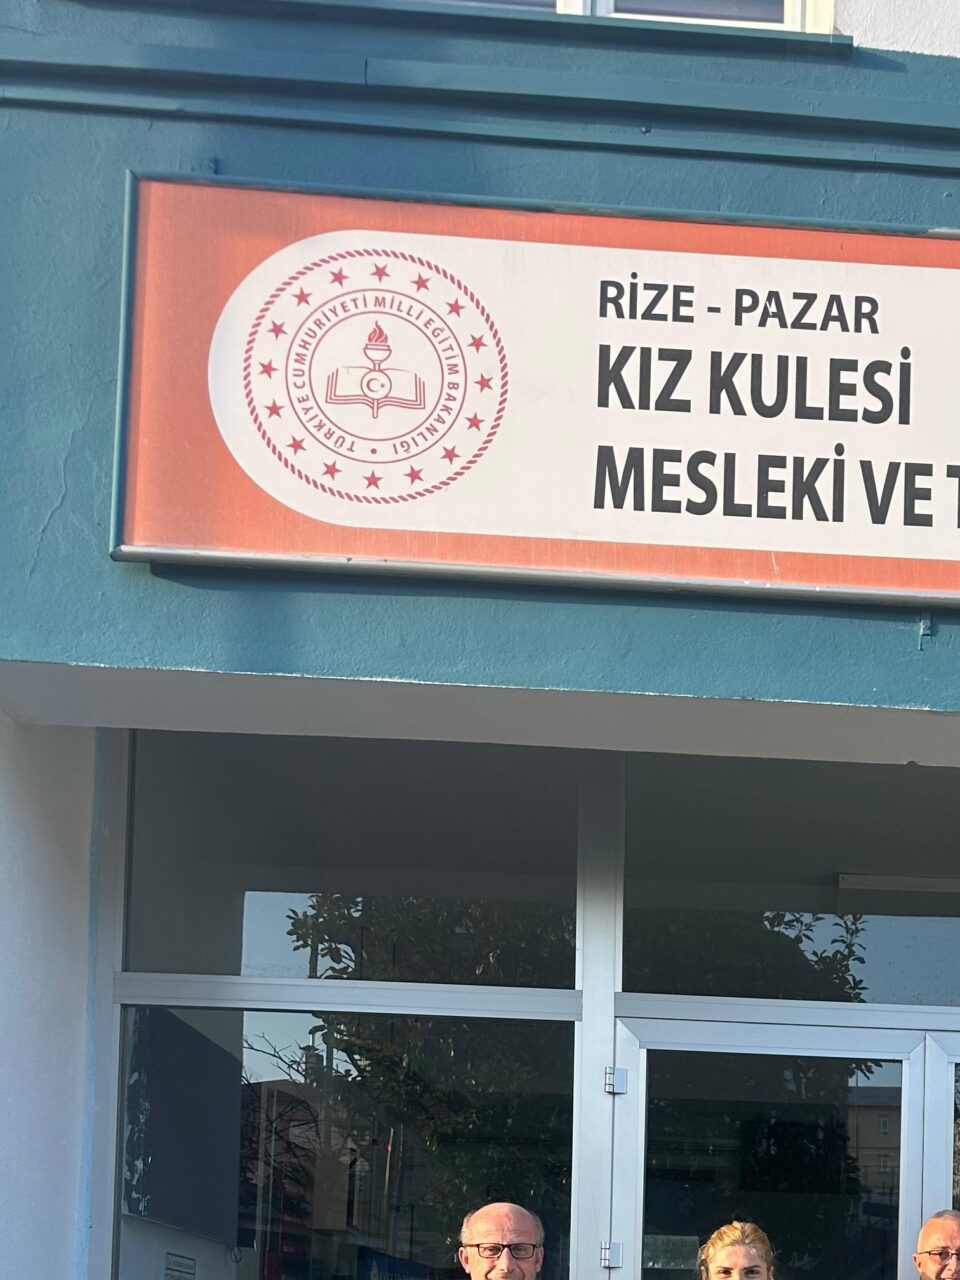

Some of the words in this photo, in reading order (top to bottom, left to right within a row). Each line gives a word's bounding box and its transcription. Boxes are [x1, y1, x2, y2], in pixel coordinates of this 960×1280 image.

[599, 271, 696, 324] RİZE
[707, 306, 721, 314] -
[734, 288, 880, 335] PAZAR
[293, 293, 368, 390] CUMHURİYETİ
[423, 317, 460, 375] EĞİTİM
[392, 381, 460, 455] BAKANLIĞI
[597, 344, 693, 413] KIZ
[709, 346, 911, 426] KULESİ
[297, 394, 356, 453] TÜRKİYE
[593, 442, 845, 523] MESLEKİ
[859, 459, 933, 528] VE
